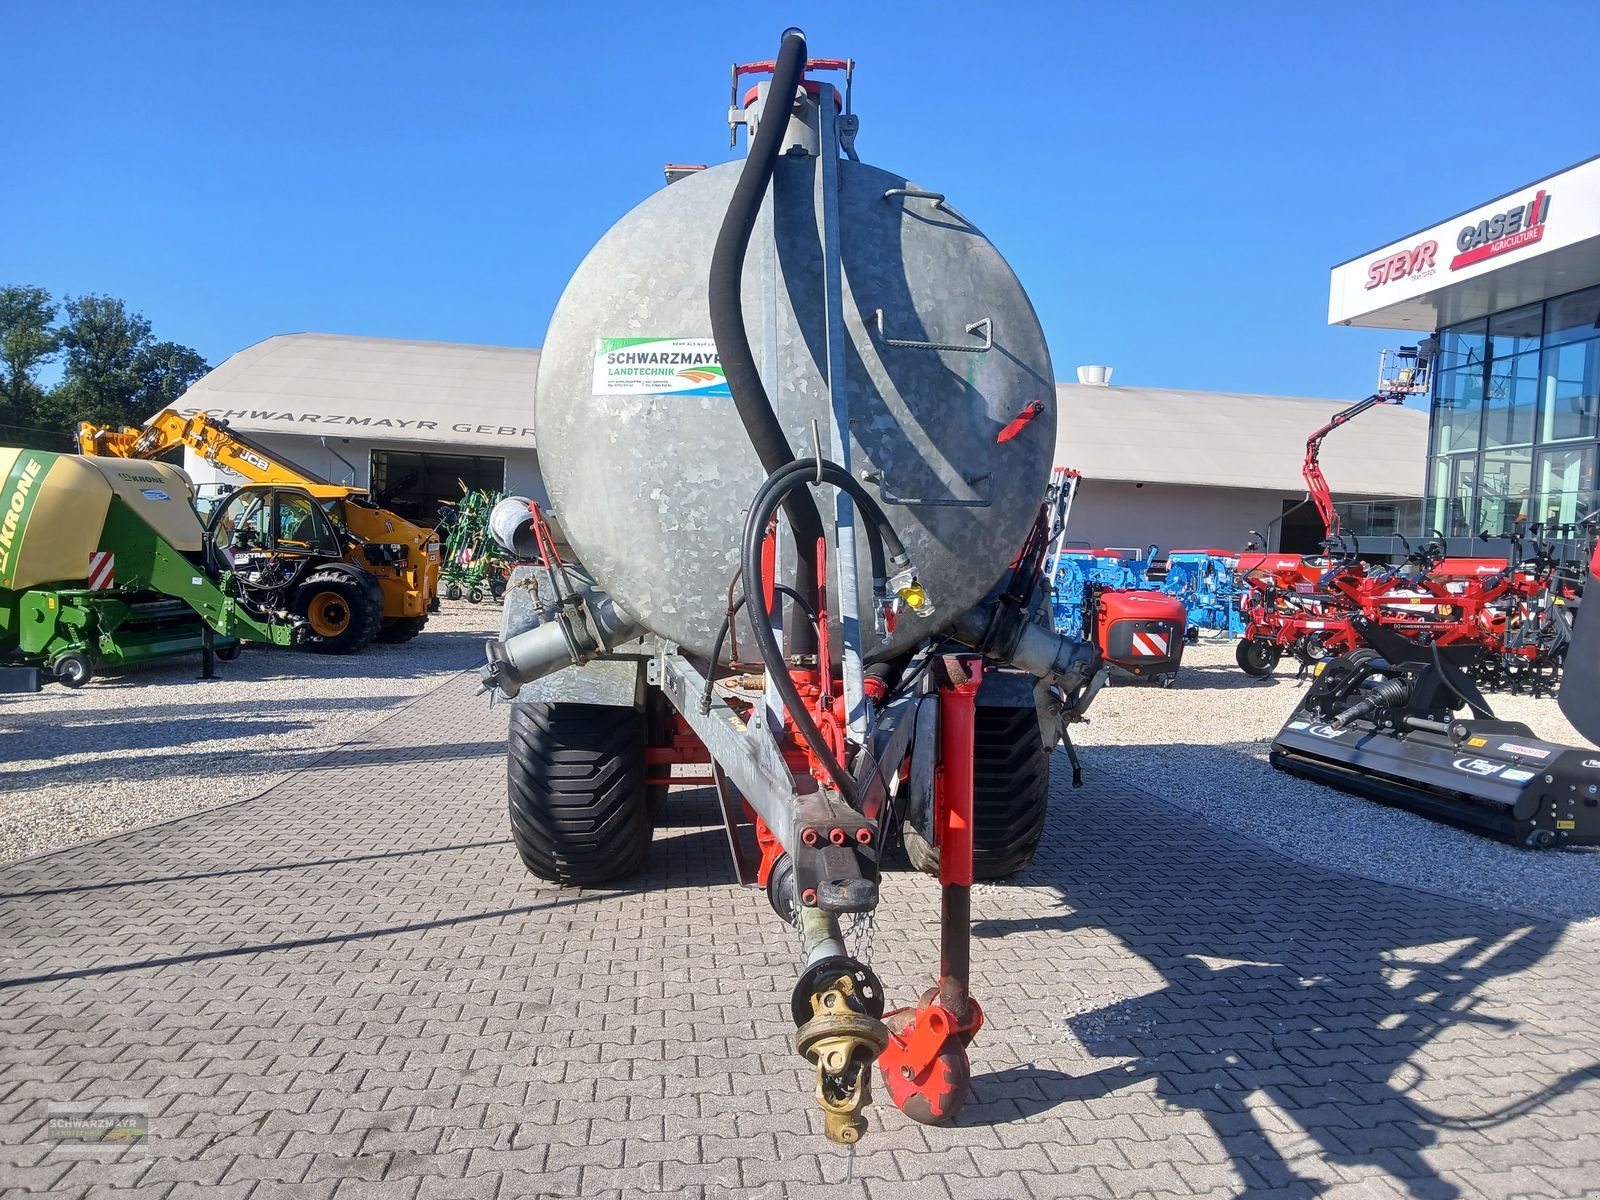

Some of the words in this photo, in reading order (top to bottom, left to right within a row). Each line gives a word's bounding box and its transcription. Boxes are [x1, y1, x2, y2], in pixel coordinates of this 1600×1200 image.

[1456, 205, 1525, 253] CASE
[1490, 230, 1539, 253] AGRICULTURE
[1365, 240, 1439, 291] STEYR
[607, 353, 721, 365] SCHWARZMAYR
[608, 368, 675, 376] LANDTECHNIK
[180, 408, 438, 430] SCHWARZMAYR
[239, 451, 269, 472] JCB
[131, 475, 165, 484] KRONE
[0, 457, 42, 549] KRONE
